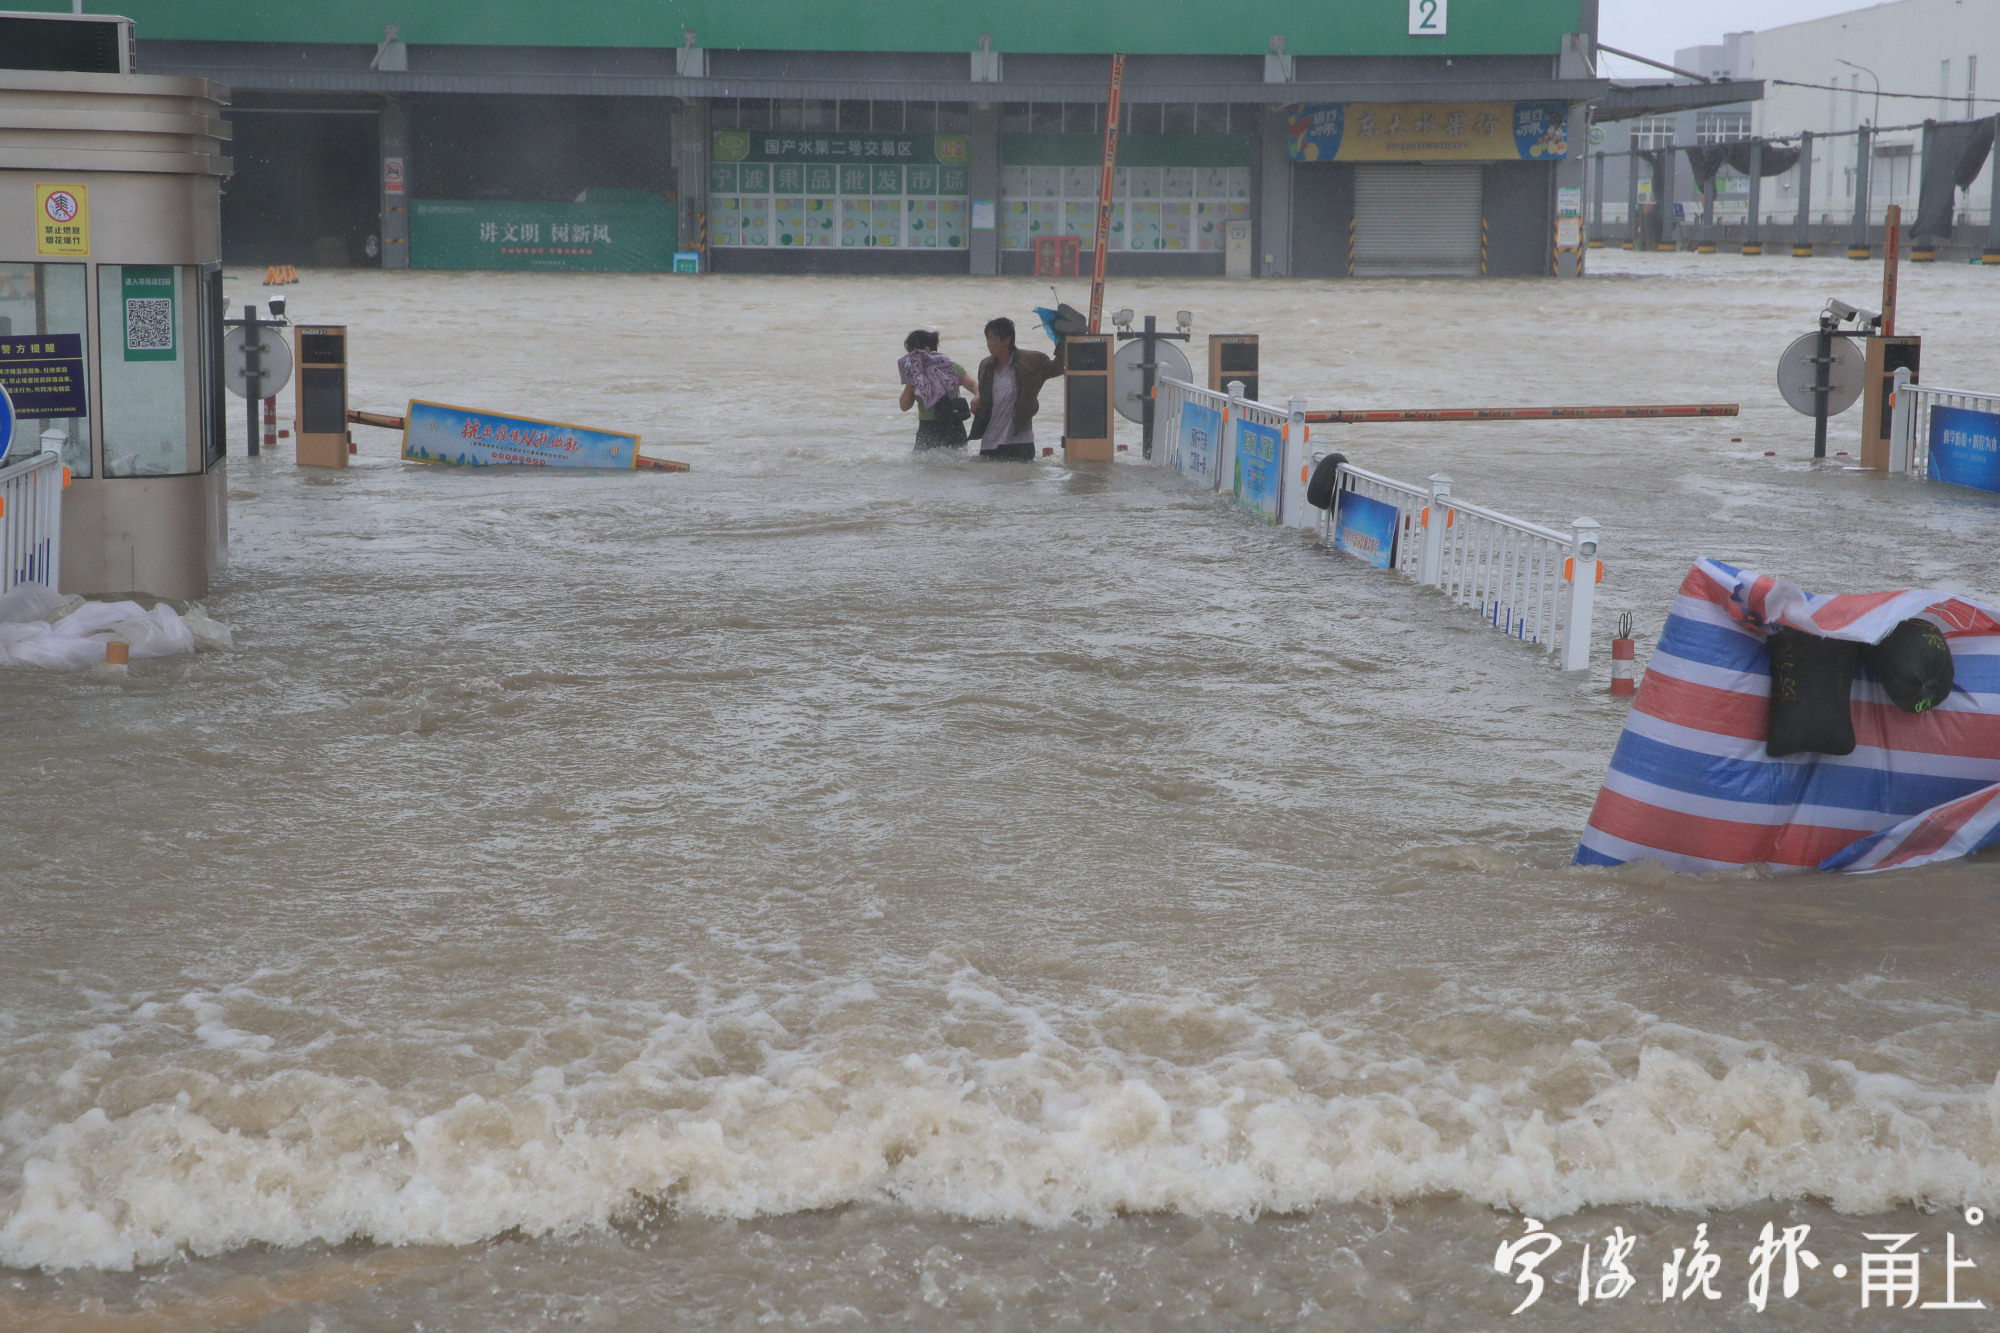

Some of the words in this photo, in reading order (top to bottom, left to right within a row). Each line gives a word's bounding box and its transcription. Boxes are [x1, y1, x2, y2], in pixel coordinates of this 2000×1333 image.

[1419, 0, 1437, 28] 2
[765, 139, 913, 156] 国产水果二号交易区
[713, 168, 964, 191] 宁波果品批发市场
[45, 225, 81, 234] 禁止燃放
[479, 221, 540, 244] 讲文明
[550, 222, 612, 244] 树新风
[45, 236, 81, 245] 烟花爆竹
[1, 343, 56, 354] 警方提醒
[460, 417, 580, 454] 抗击疫情从我做起
